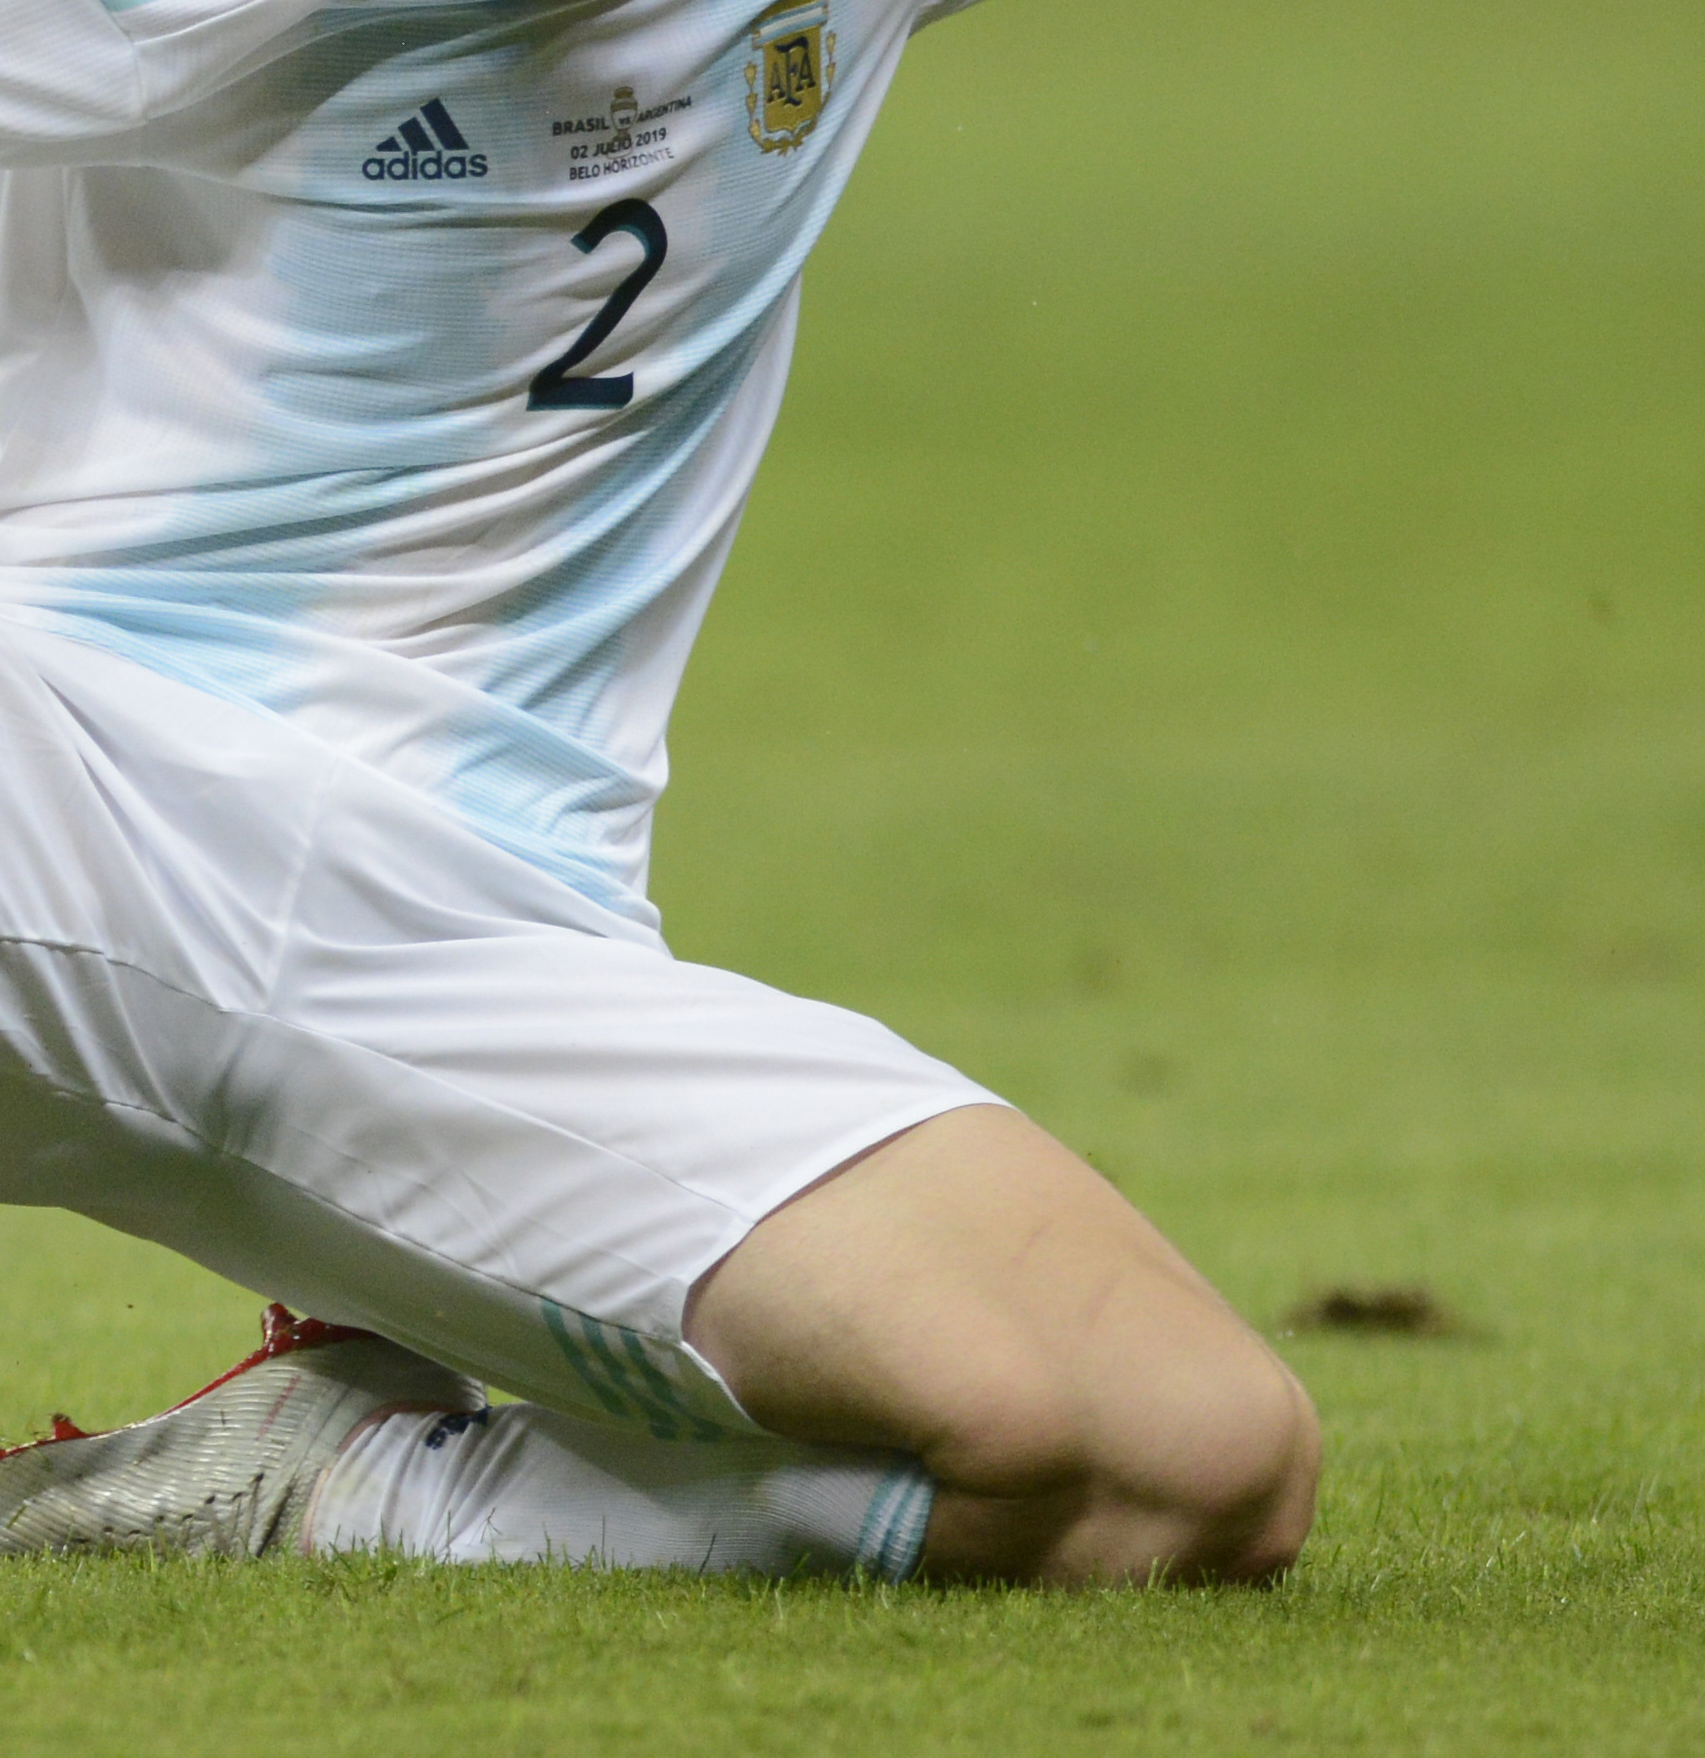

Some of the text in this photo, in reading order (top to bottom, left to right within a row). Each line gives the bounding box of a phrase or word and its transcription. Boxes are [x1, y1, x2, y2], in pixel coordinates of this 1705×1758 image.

[767, 36, 816, 106] AFA
[552, 117, 610, 136] BRASIL
[637, 96, 693, 123] ARGENTINA
[570, 127, 668, 160] 02 JULIO 2019
[362, 148, 489, 181] adidas
[569, 147, 675, 181] BELO HORIZONTE
[526, 197, 669, 412] 2
